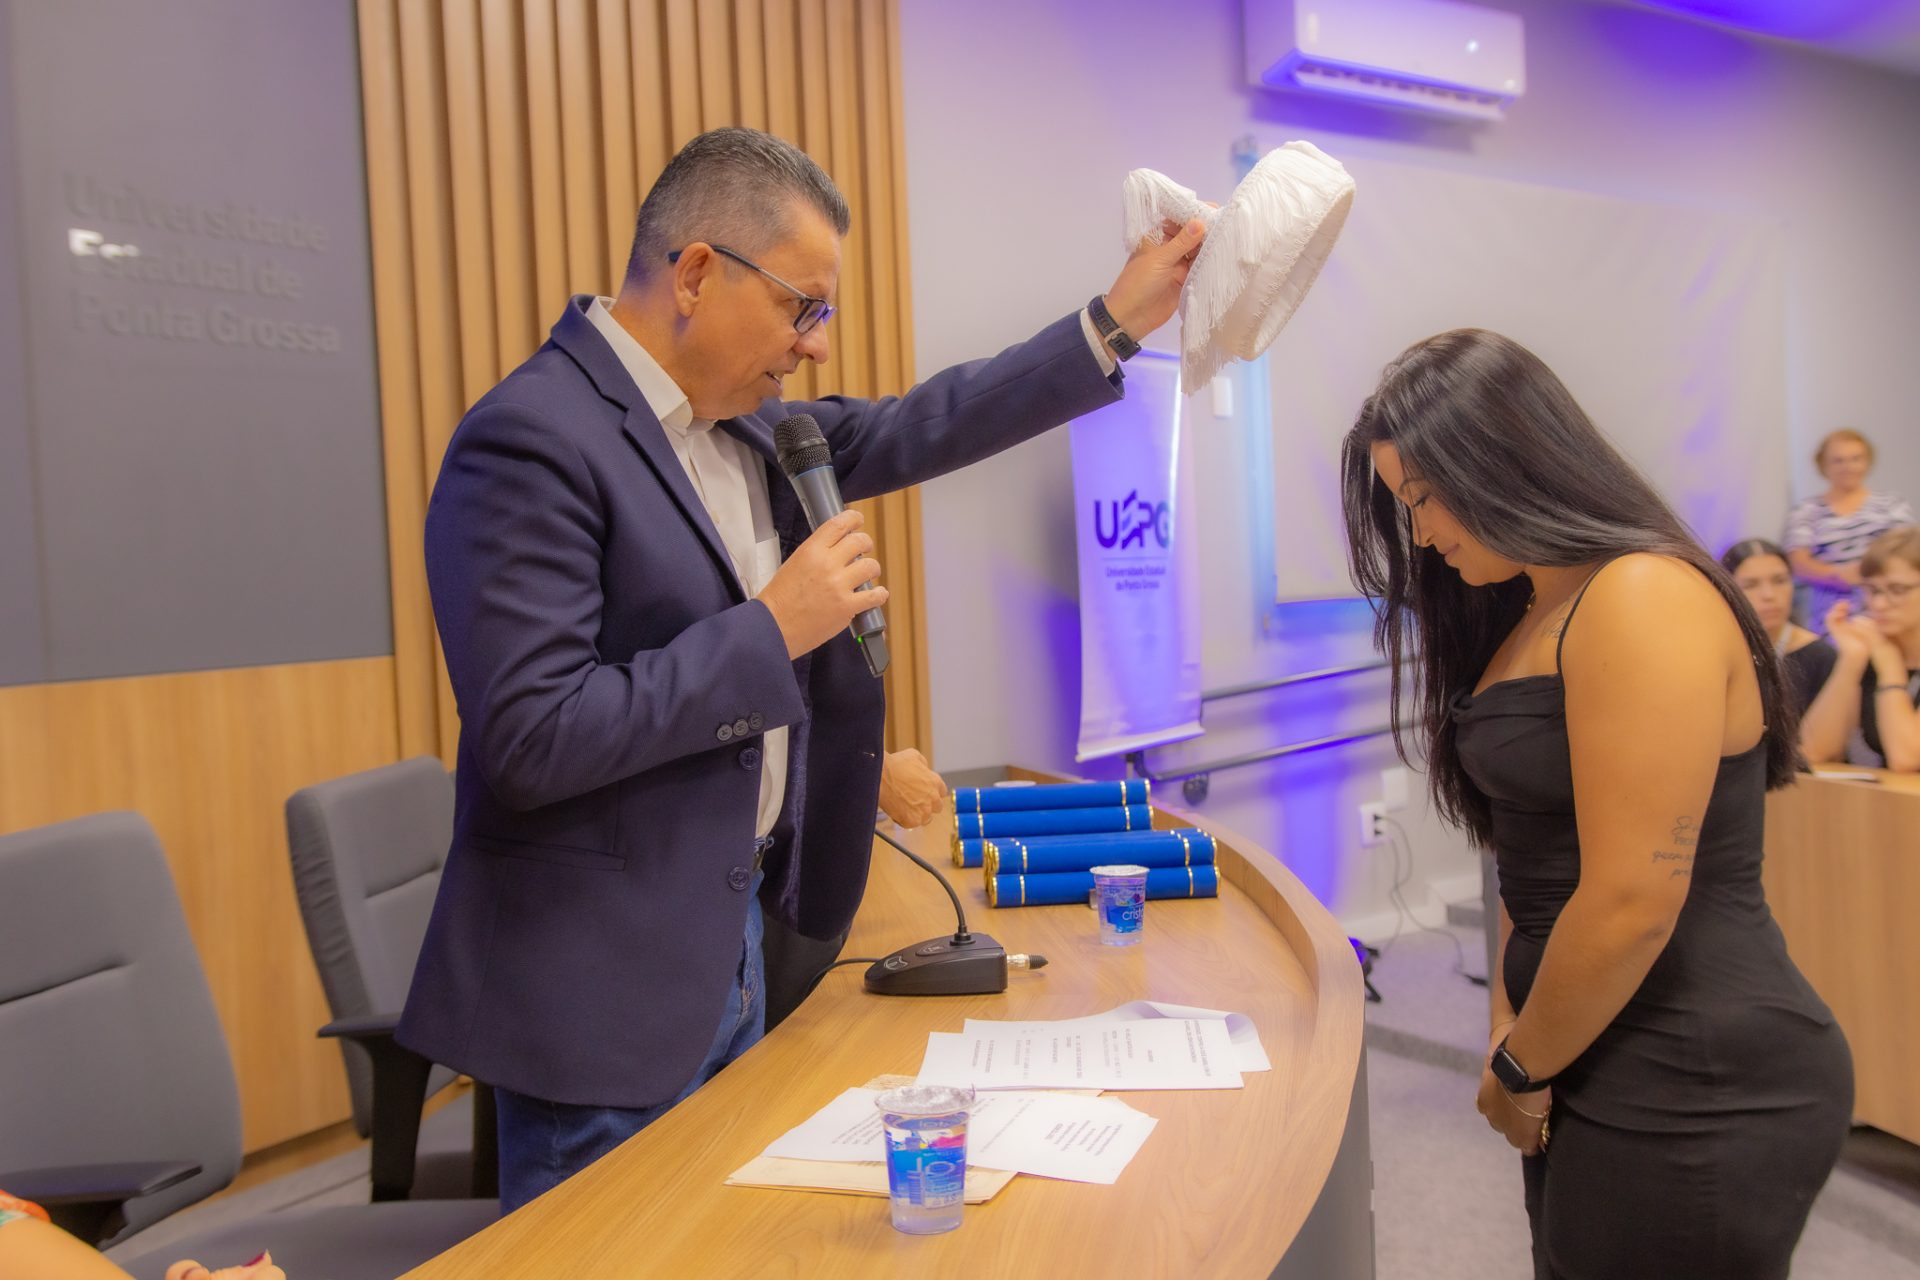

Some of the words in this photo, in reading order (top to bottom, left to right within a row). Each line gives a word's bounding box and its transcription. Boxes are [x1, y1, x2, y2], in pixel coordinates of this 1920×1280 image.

[62, 172, 330, 253] Universidade
[254, 256, 304, 301] de
[68, 288, 203, 343] Ponta
[206, 302, 342, 354] Grossa
